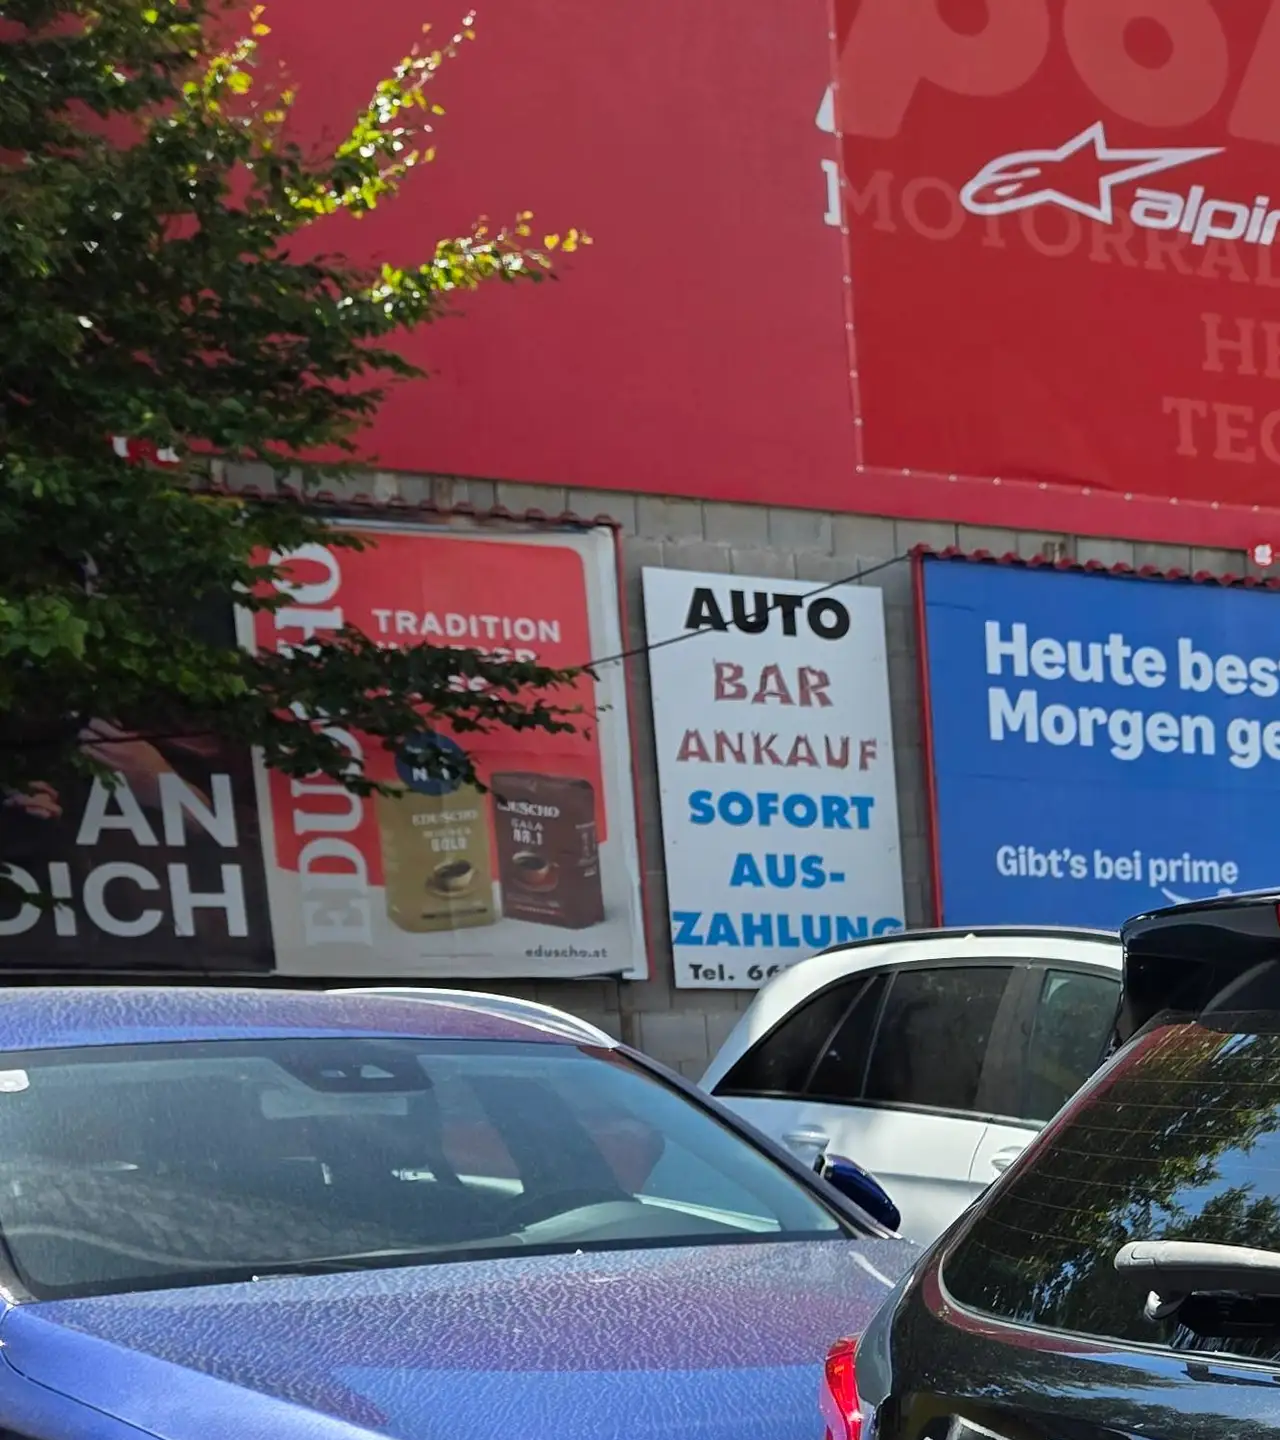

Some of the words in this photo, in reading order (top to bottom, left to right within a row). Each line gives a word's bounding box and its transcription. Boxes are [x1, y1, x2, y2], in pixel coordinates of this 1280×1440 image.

[371, 609, 561, 644] TRADITION
[685, 587, 850, 640] AUTO
[984, 619, 1167, 689] Heute
[713, 658, 834, 707] BAR
[268, 541, 374, 947] EDUHO
[987, 686, 1216, 762] Morgen
[676, 728, 878, 771] ANKAUF
[76, 771, 239, 848] AN
[688, 790, 875, 830] SOFORT
[729, 852, 846, 889] AUS-
[996, 845, 1088, 880] Gibt's
[1093, 848, 1143, 882] bei
[1148, 851, 1240, 885] prime
[525, 944, 608, 959] eduscho.at
[689, 963, 736, 982] Tel.
